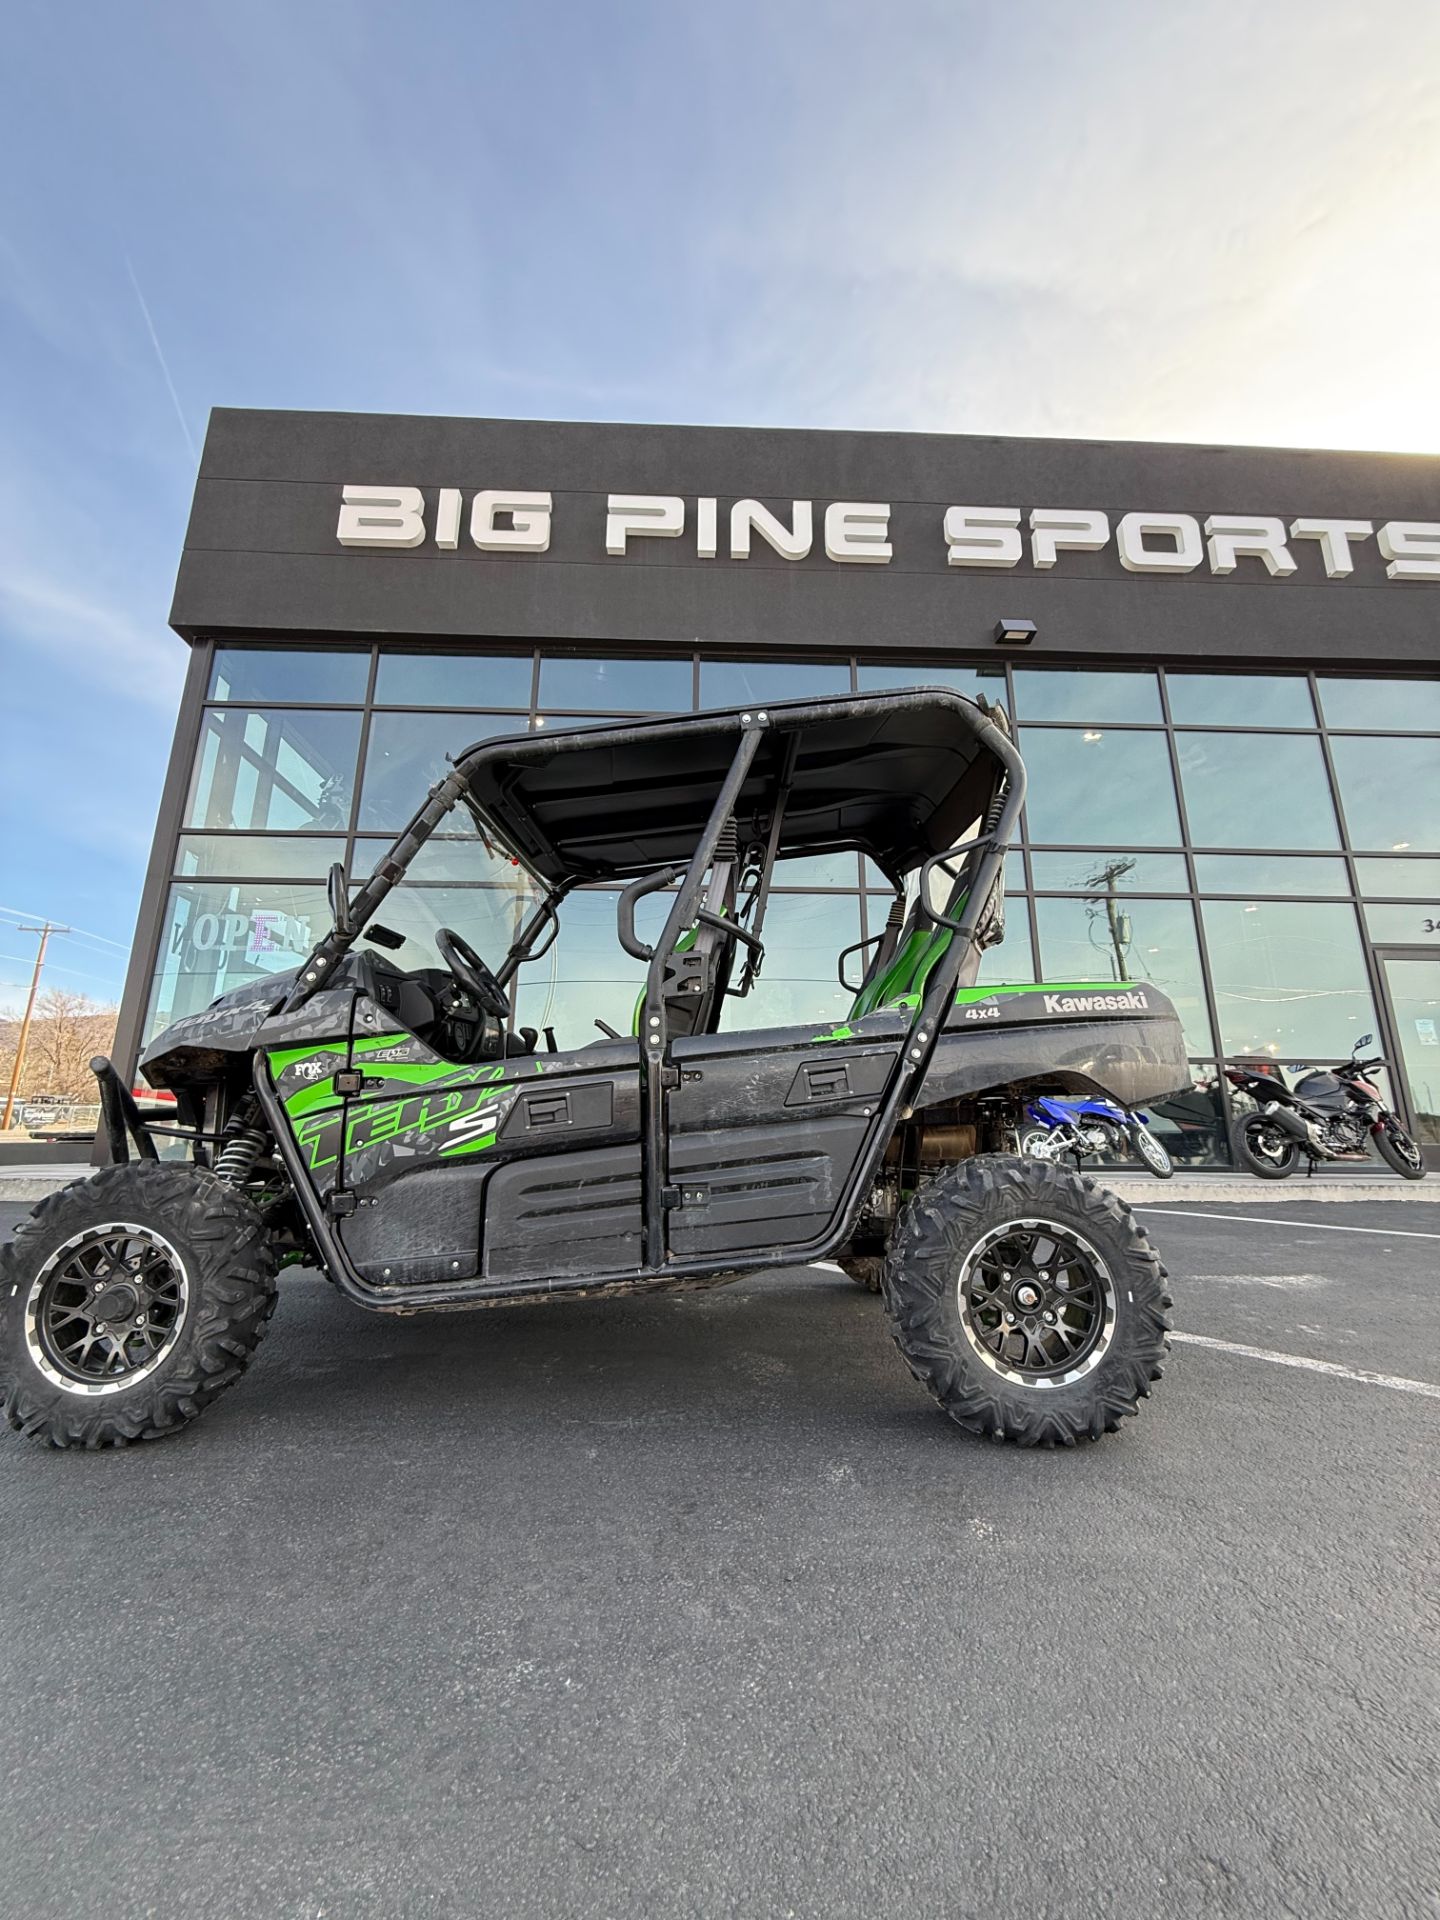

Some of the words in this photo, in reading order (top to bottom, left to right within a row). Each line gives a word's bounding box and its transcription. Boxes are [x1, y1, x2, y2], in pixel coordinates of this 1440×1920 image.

[336, 485, 552, 553] BIG
[606, 494, 893, 564] PINE
[943, 506, 1440, 580] SPORTS
[192, 913, 311, 952] OPEN
[1043, 992, 1149, 1013] Kawasaki
[965, 1007, 1000, 1020] 4x4
[294, 1062, 322, 1080] FOX
